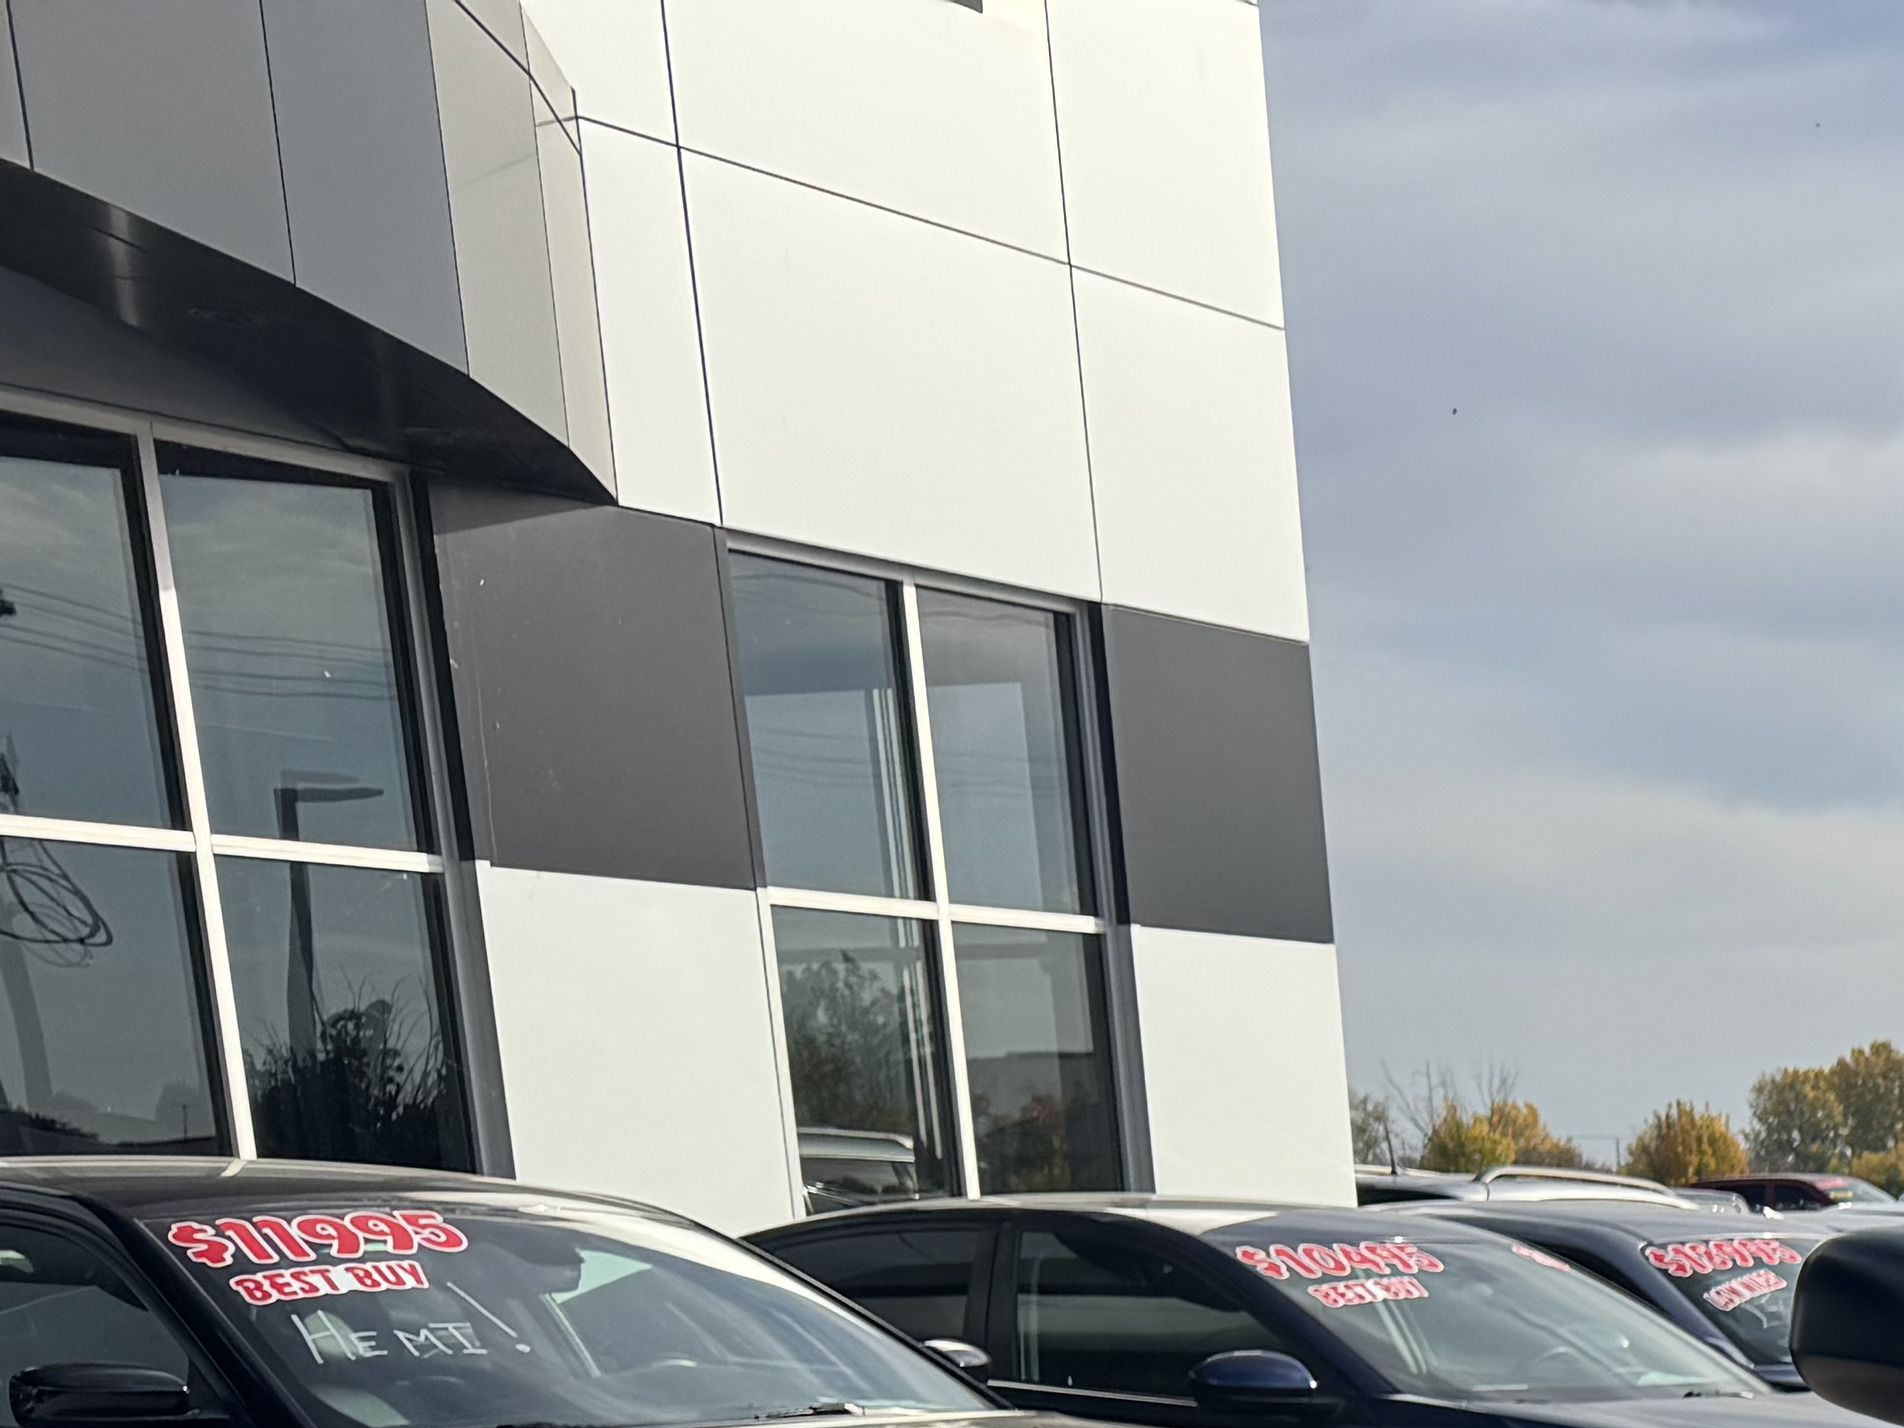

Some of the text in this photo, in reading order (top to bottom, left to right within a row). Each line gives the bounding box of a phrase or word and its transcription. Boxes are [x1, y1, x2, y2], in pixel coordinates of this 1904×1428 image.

[169, 1211, 468, 1267] $11995
[232, 1261, 429, 1304] BEST BUY
